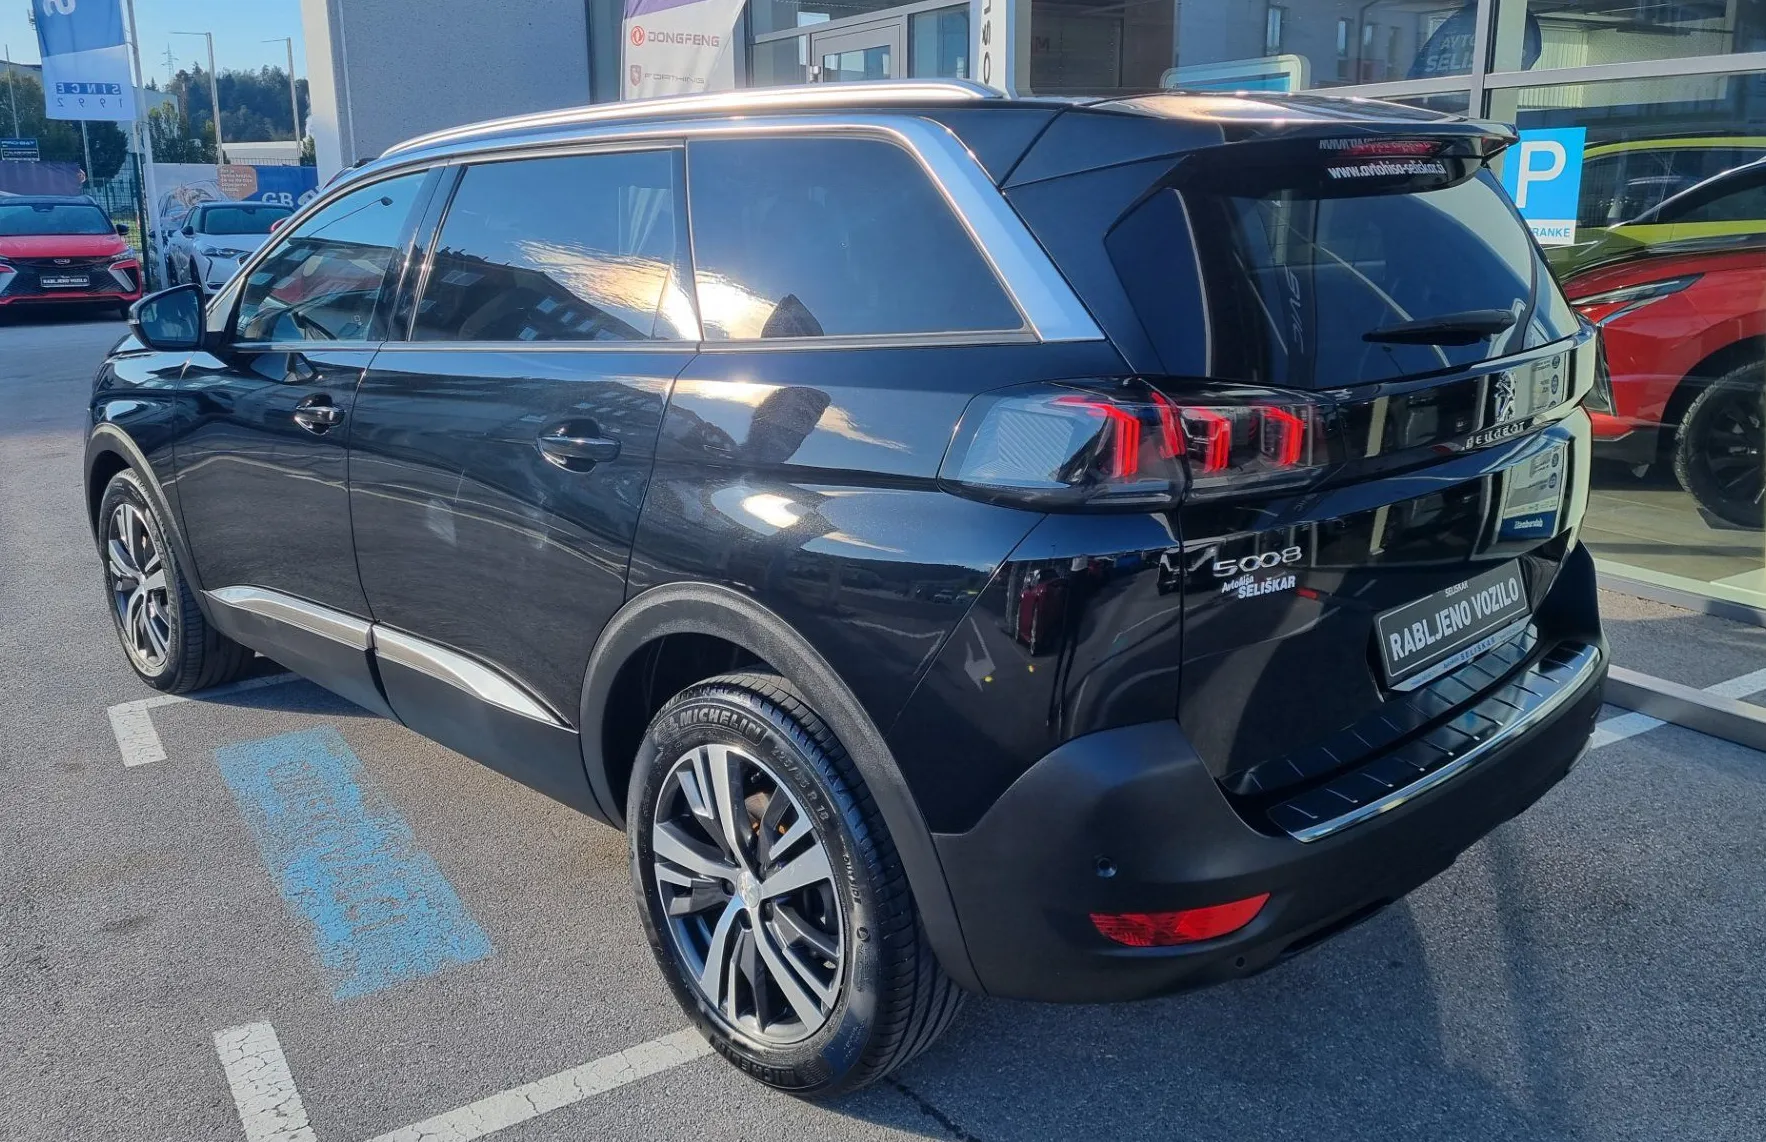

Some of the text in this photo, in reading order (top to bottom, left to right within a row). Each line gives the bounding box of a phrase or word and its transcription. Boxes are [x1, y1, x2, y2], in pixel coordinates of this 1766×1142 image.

[648, 31, 720, 47] DONGFENG
[1425, 51, 1474, 73] SELI
[644, 73, 705, 84] FORTHING
[1515, 140, 1567, 208] P
[1531, 227, 1570, 237] RANKE
[1465, 421, 1525, 449] PEUGEOT
[1212, 546, 1302, 577] 5008
[1238, 575, 1296, 599] SELIŠKAR
[1389, 577, 1519, 661] RABLJENO VOZILO
[680, 707, 762, 739] MICHELIN
